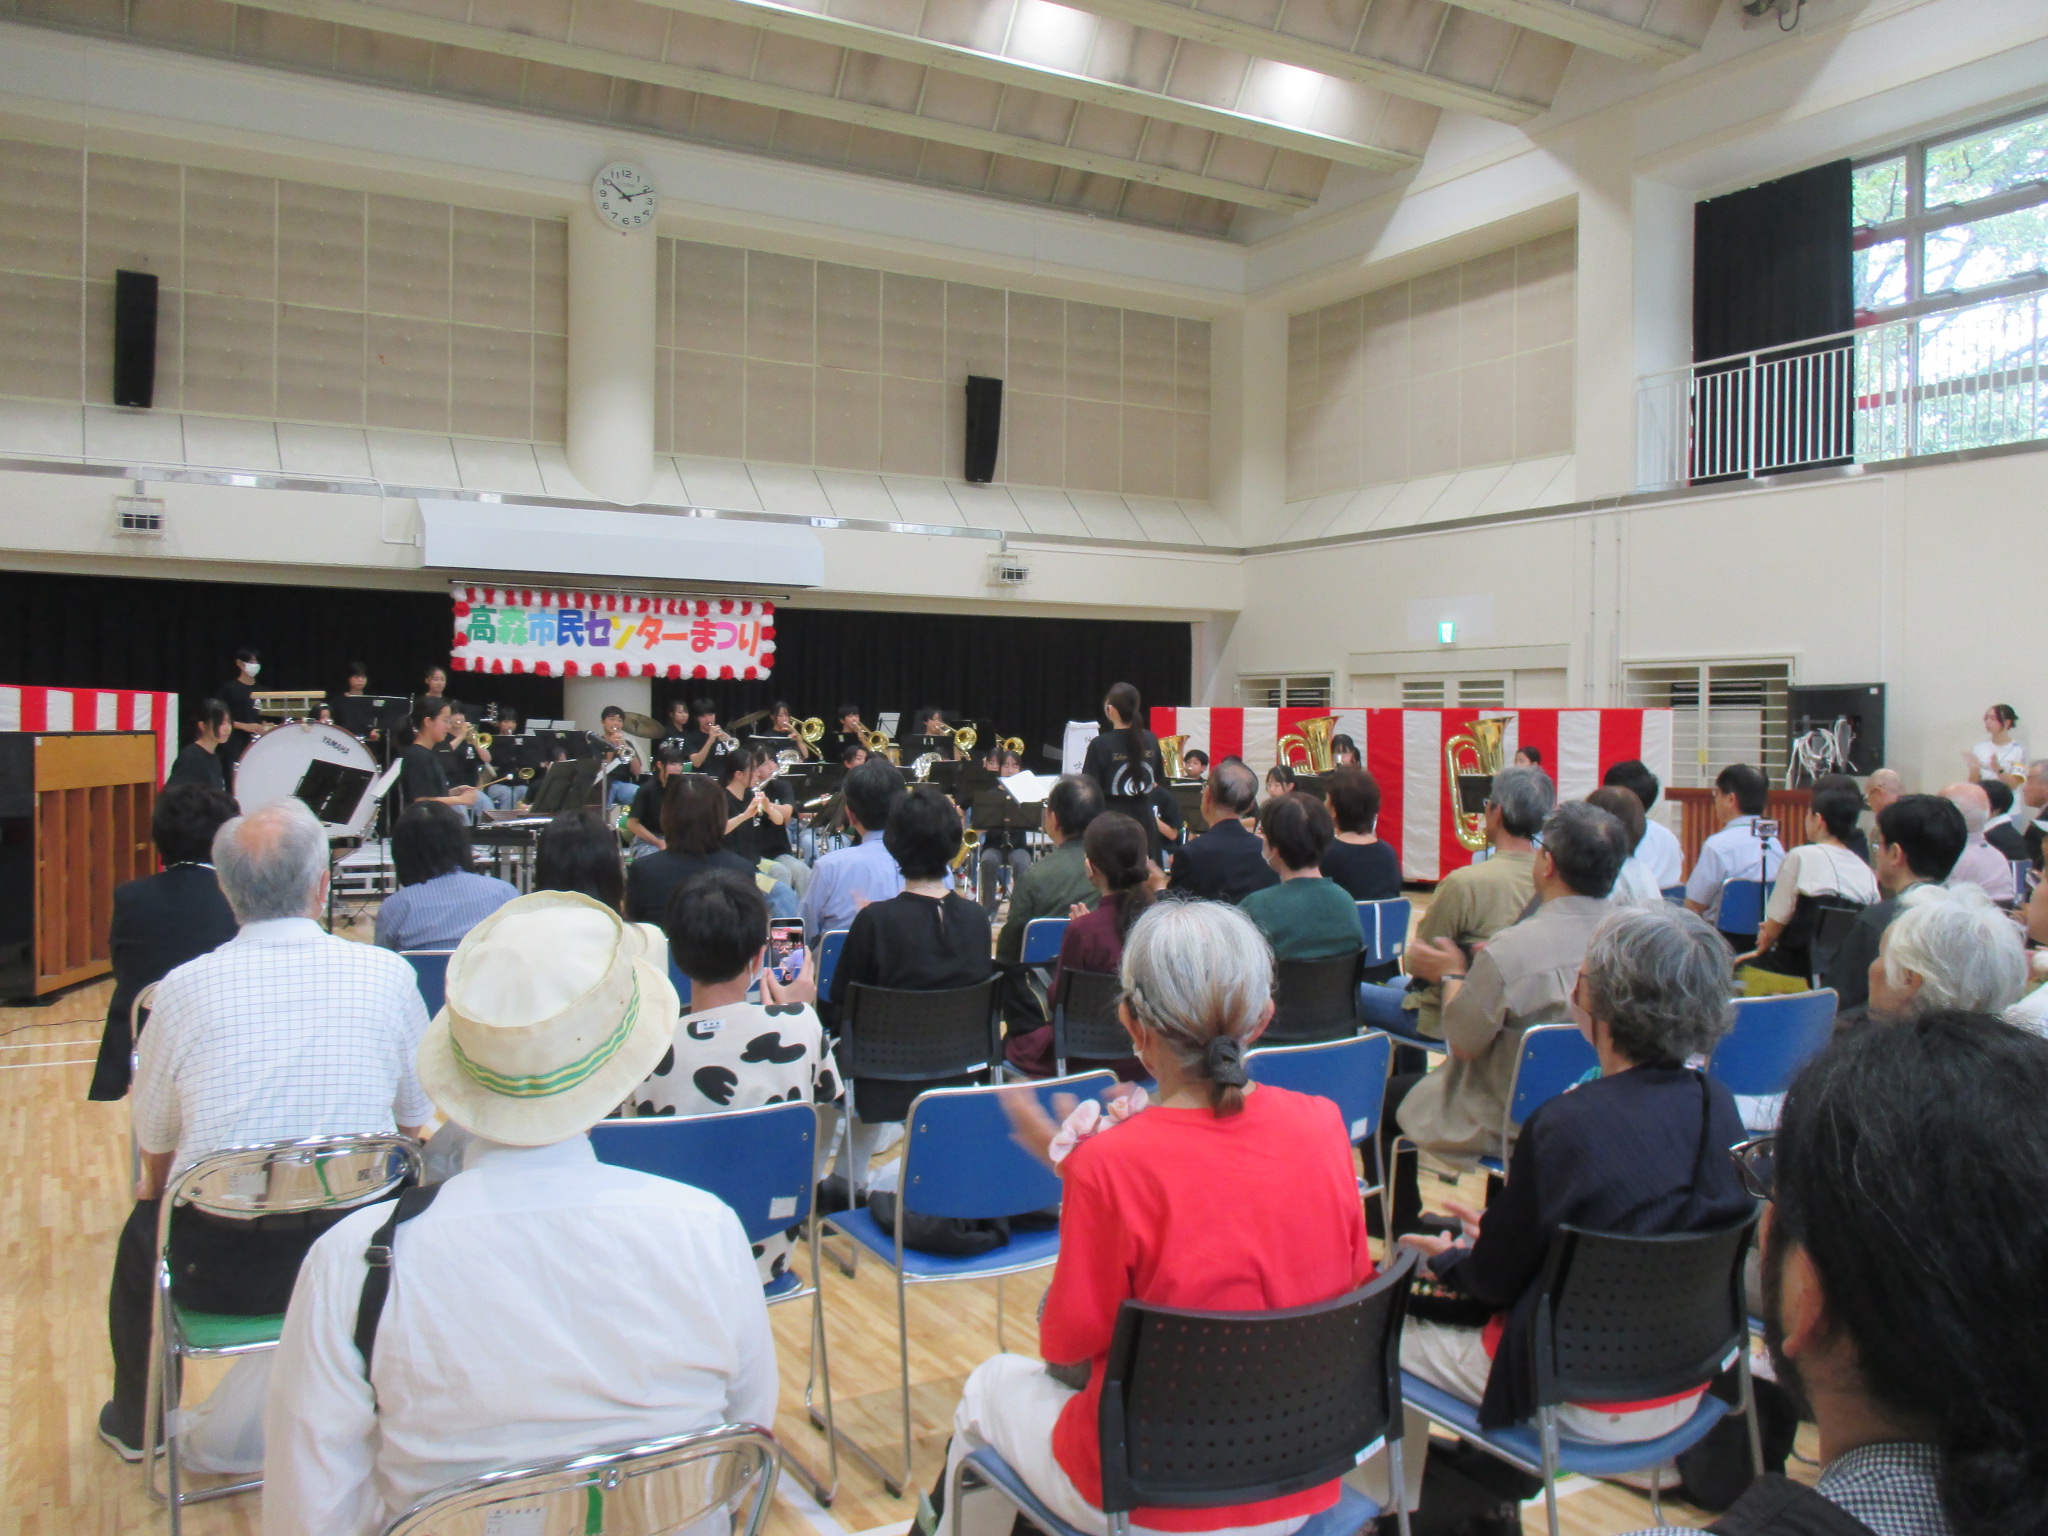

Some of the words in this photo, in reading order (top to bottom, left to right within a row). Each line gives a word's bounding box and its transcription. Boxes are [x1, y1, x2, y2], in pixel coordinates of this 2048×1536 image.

[622, 170, 632, 178] 12
[622, 217, 629, 225] 6
[465, 605, 760, 656] 高森市民センターまつり
[322, 736, 350, 755] YAMAHA
